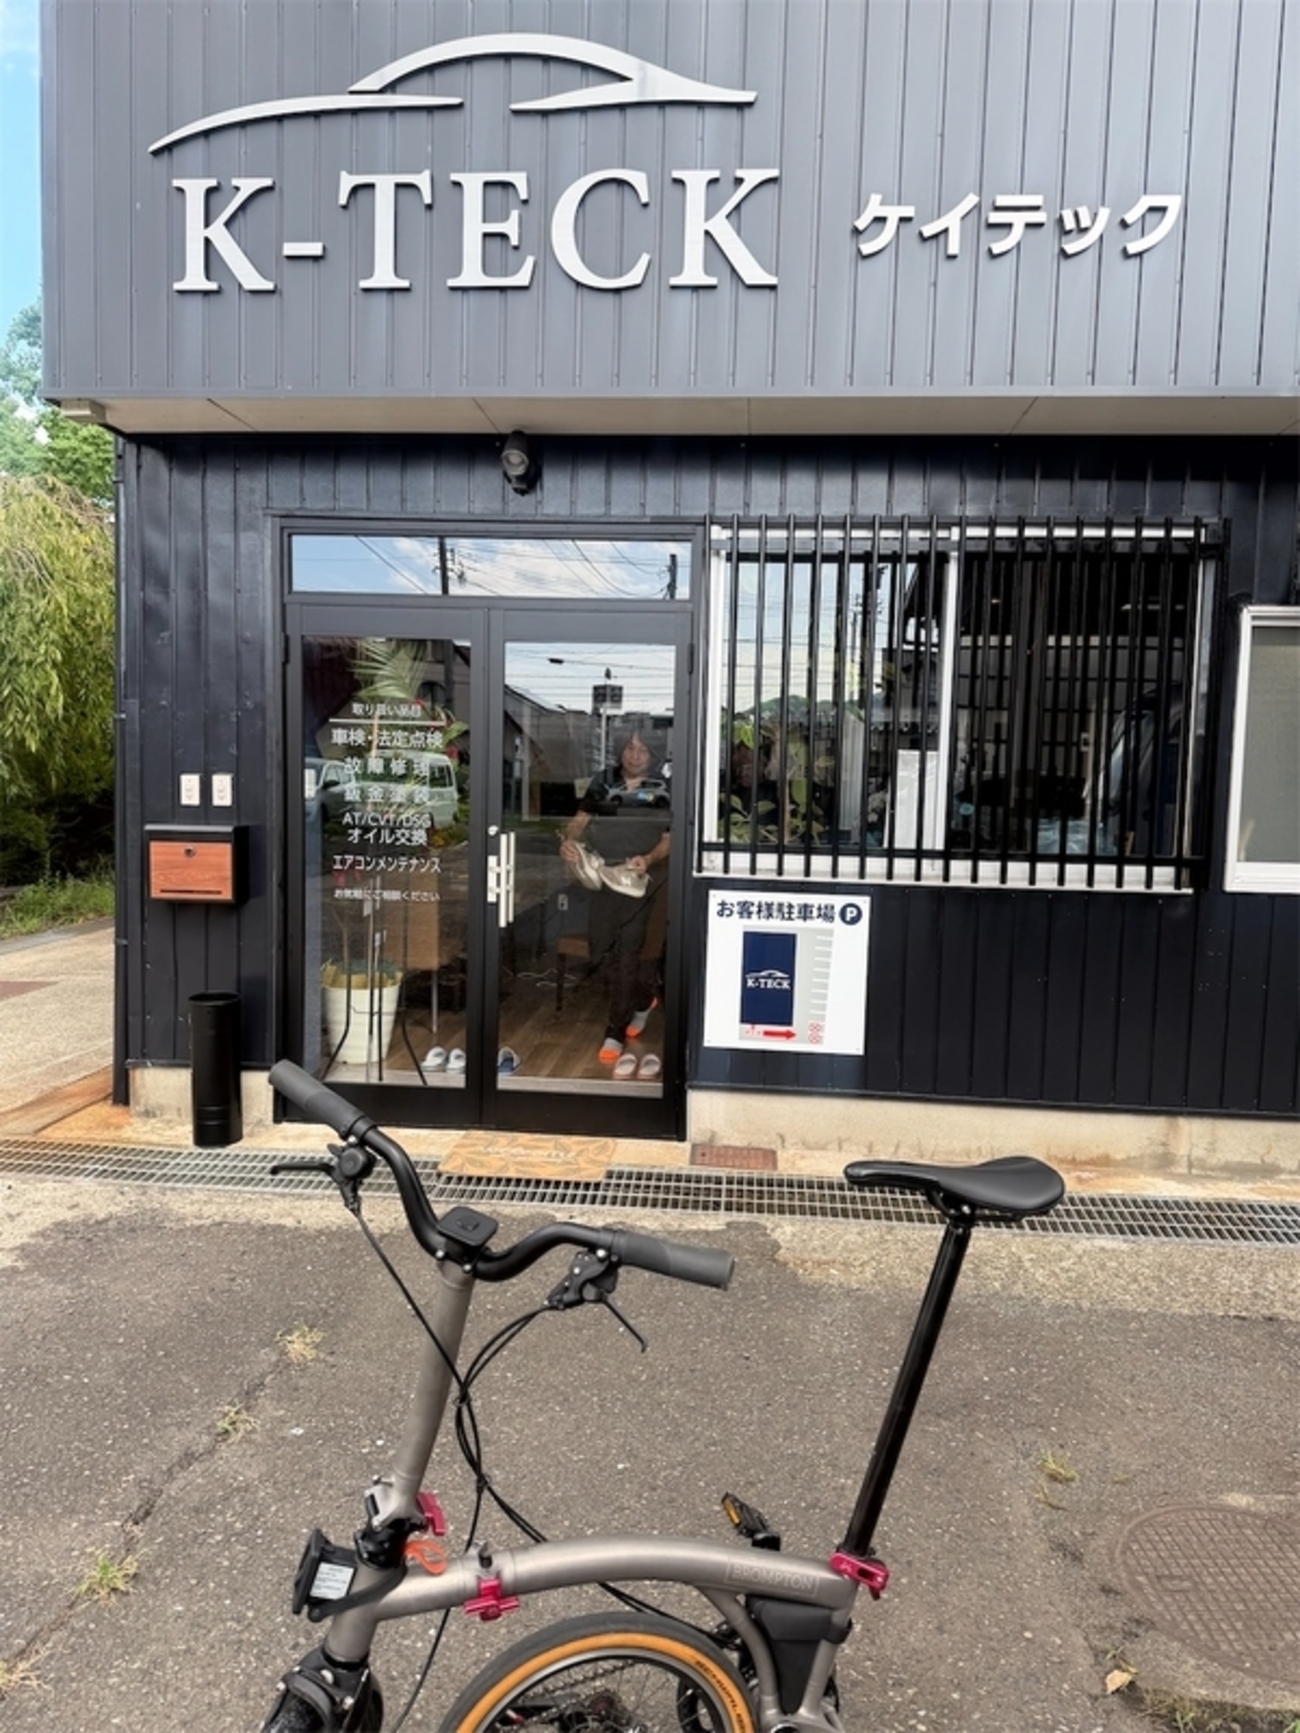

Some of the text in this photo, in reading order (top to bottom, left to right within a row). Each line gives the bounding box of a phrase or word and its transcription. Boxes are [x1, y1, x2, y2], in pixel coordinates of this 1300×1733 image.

[172, 167, 781, 293] K-TECK
[853, 192, 1183, 257] ケイテック
[346, 828, 428, 846] オイル交換
[332, 854, 442, 873] エアコンメンテナンス
[716, 900, 836, 923] お客様駐車場
[746, 978, 791, 990] K-TECK
[732, 1563, 814, 1590] BROMPTON
